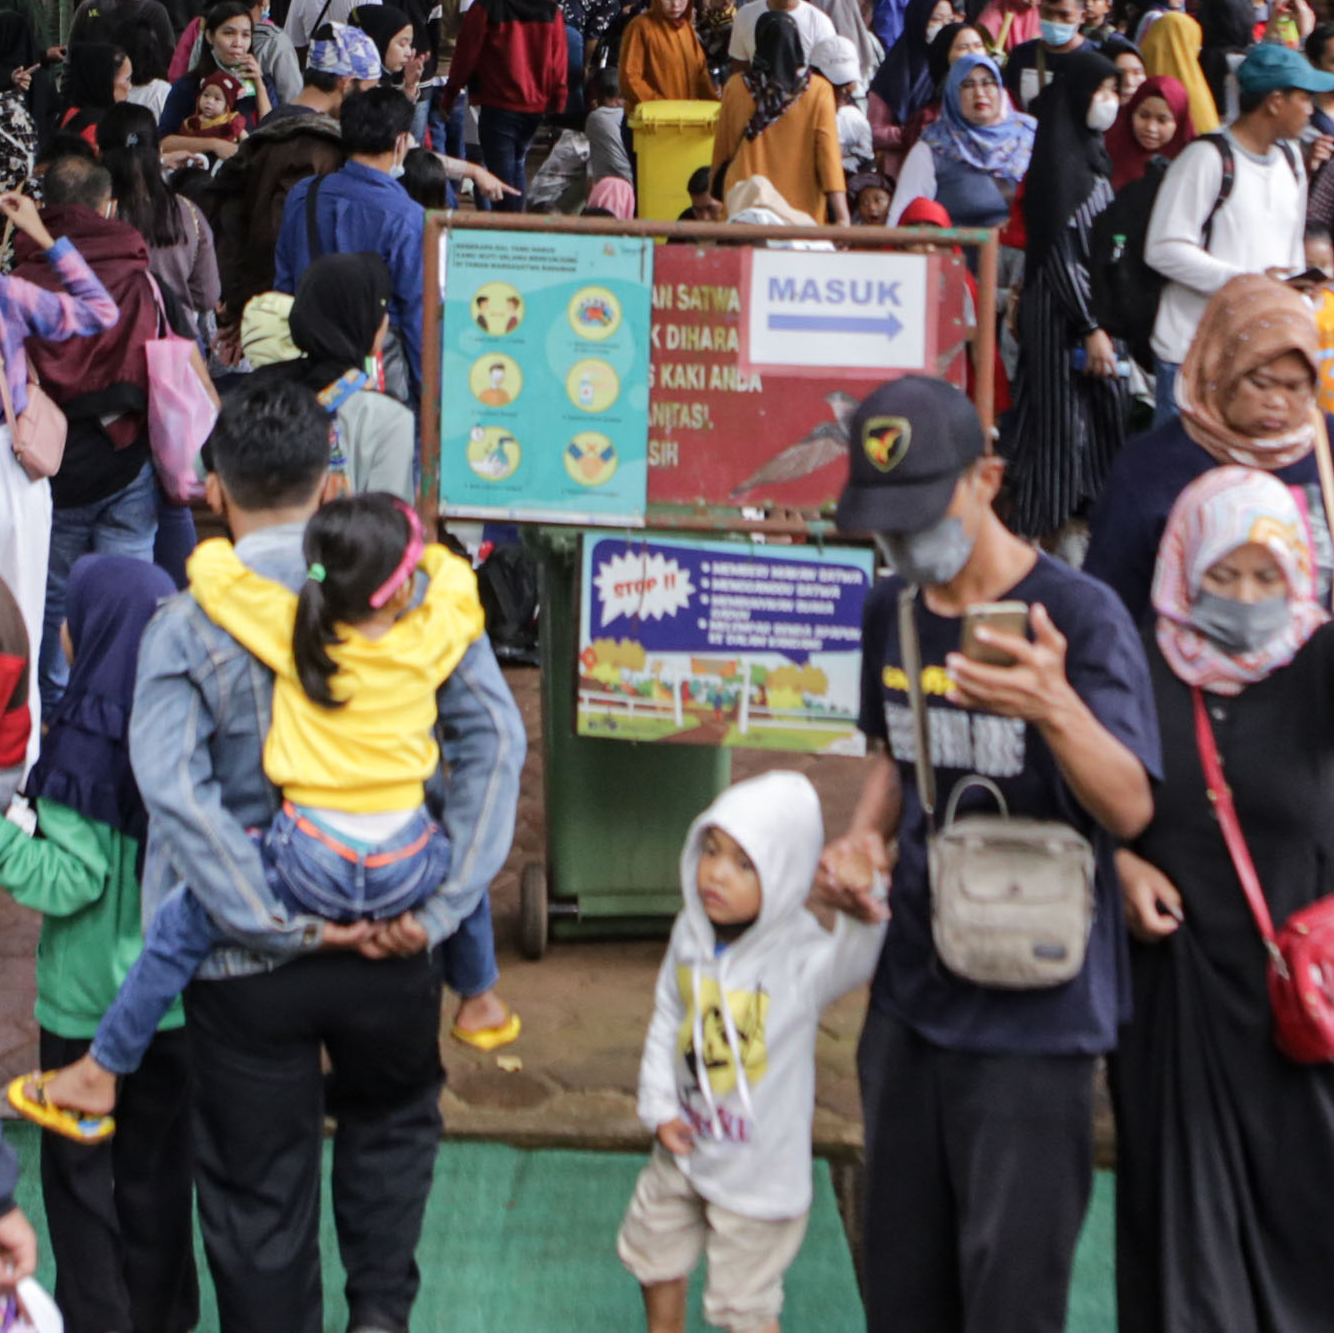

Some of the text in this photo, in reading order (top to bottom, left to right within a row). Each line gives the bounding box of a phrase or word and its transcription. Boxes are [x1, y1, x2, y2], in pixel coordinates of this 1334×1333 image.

[677, 283, 741, 313] SATWA
[768, 276, 902, 306] MASUK
[666, 324, 739, 352] DIHARA
[660, 362, 705, 390] KAKI
[613, 577, 657, 598] STOP
